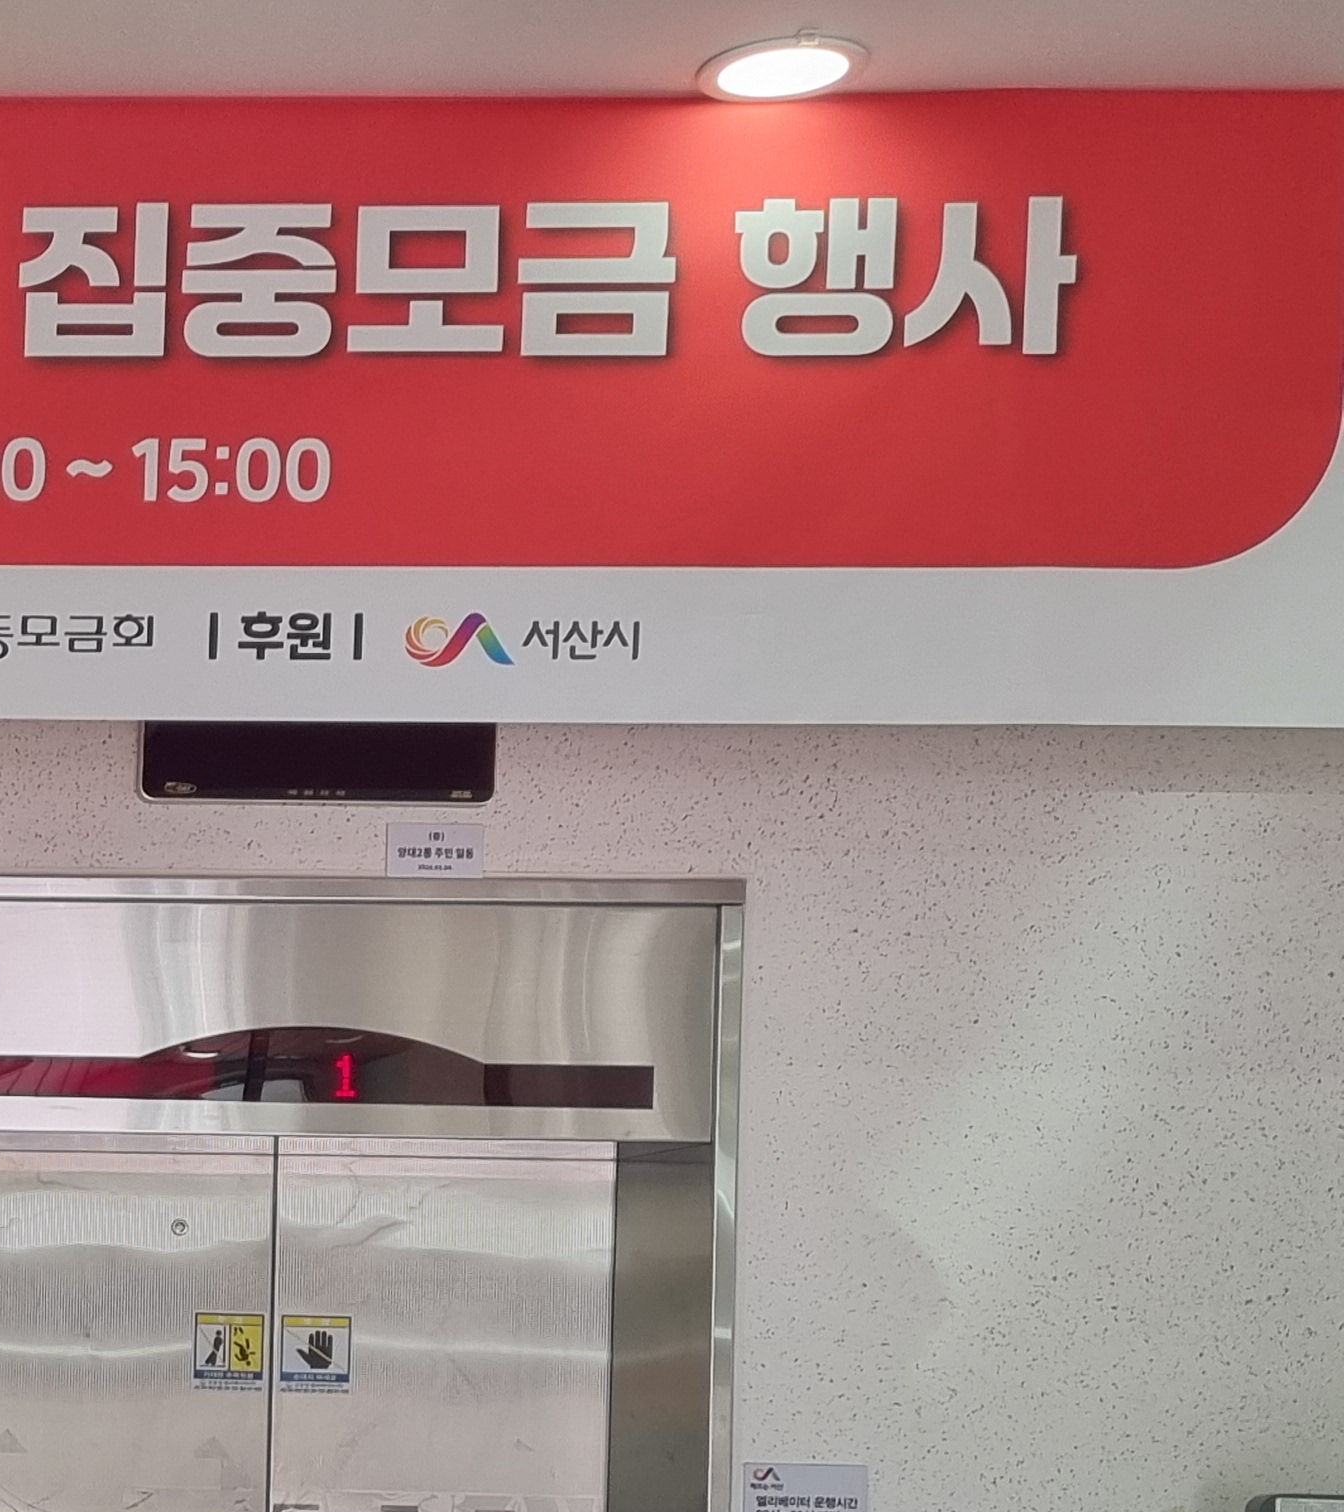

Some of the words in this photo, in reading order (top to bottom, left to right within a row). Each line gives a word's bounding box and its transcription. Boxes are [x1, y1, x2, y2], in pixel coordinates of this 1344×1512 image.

[17, 199, 679, 361] 집중모금
[733, 194, 1079, 358] 행사
[132, 437, 332, 503] 15:00
[237, 611, 332, 661] 후원
[522, 620, 641, 661] 서산시
[334, 1053, 356, 1100] 1
